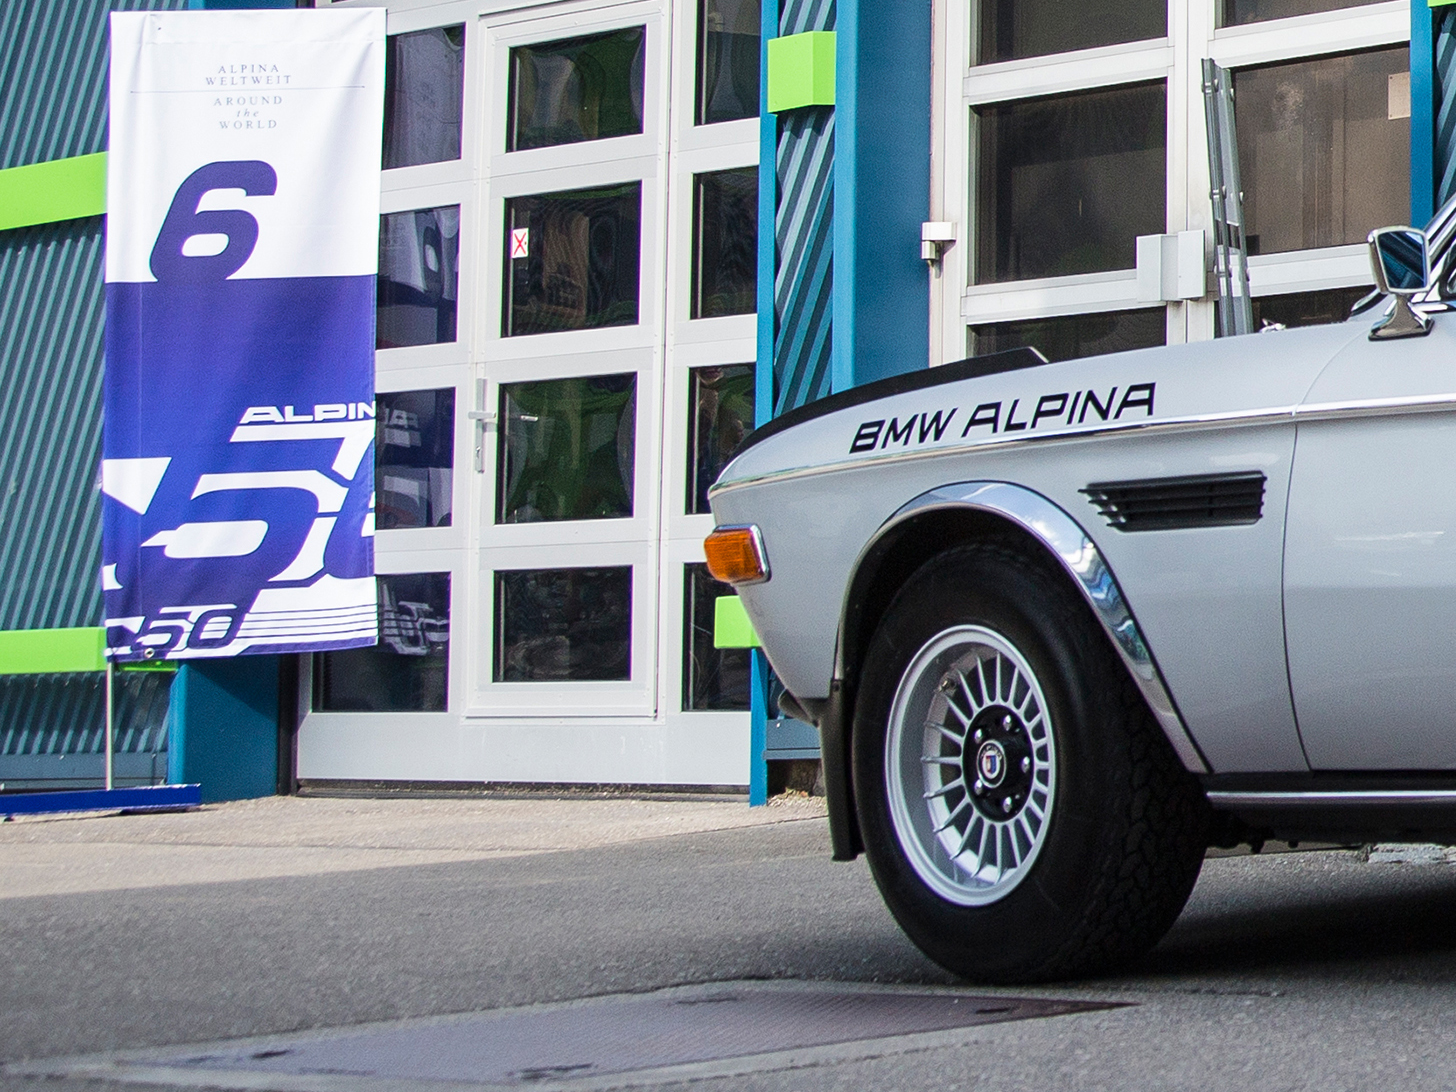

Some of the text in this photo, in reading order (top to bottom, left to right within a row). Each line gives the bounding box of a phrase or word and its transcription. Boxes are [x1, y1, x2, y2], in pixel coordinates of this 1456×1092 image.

[218, 64, 279, 74] ALPINA
[205, 75, 292, 86] WELTWEIT
[213, 95, 283, 106] AROUND
[236, 108, 260, 118] the
[219, 119, 277, 130] WORLD
[149, 159, 278, 282] 6
[849, 382, 1156, 454] BMW ALPINA
